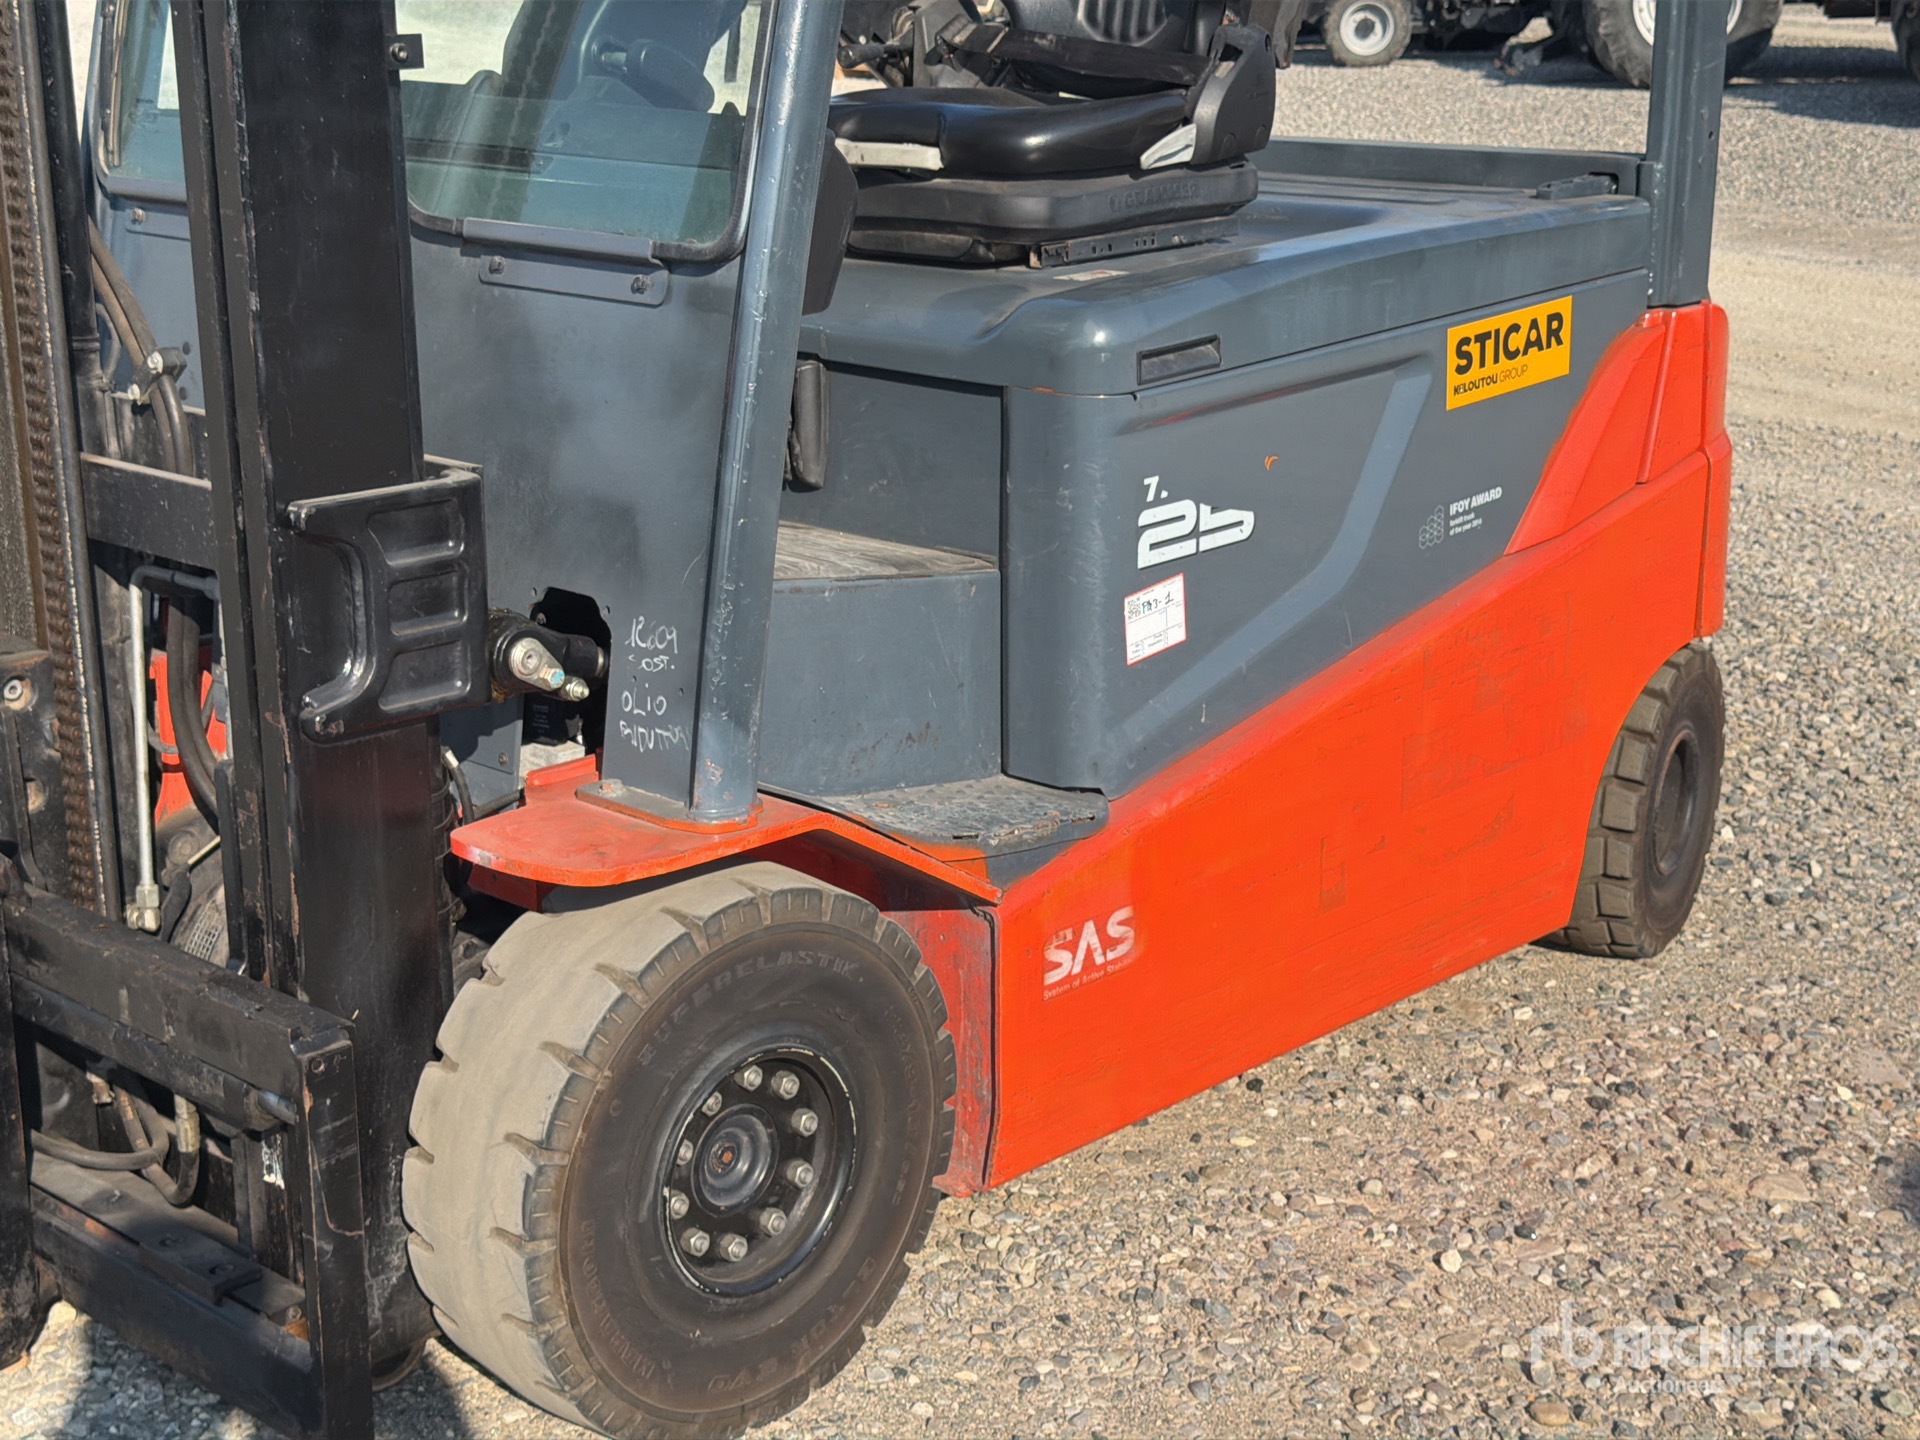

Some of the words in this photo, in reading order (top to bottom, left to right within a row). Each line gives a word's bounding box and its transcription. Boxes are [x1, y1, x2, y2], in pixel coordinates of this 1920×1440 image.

[1454, 311, 1564, 376] STICAR
[1498, 364, 1528, 382] GROUP
[1449, 497, 1471, 516] IFOY
[1470, 486, 1503, 509] AWARD
[1043, 905, 1136, 986] SAS
[1071, 978, 1080, 989] of
